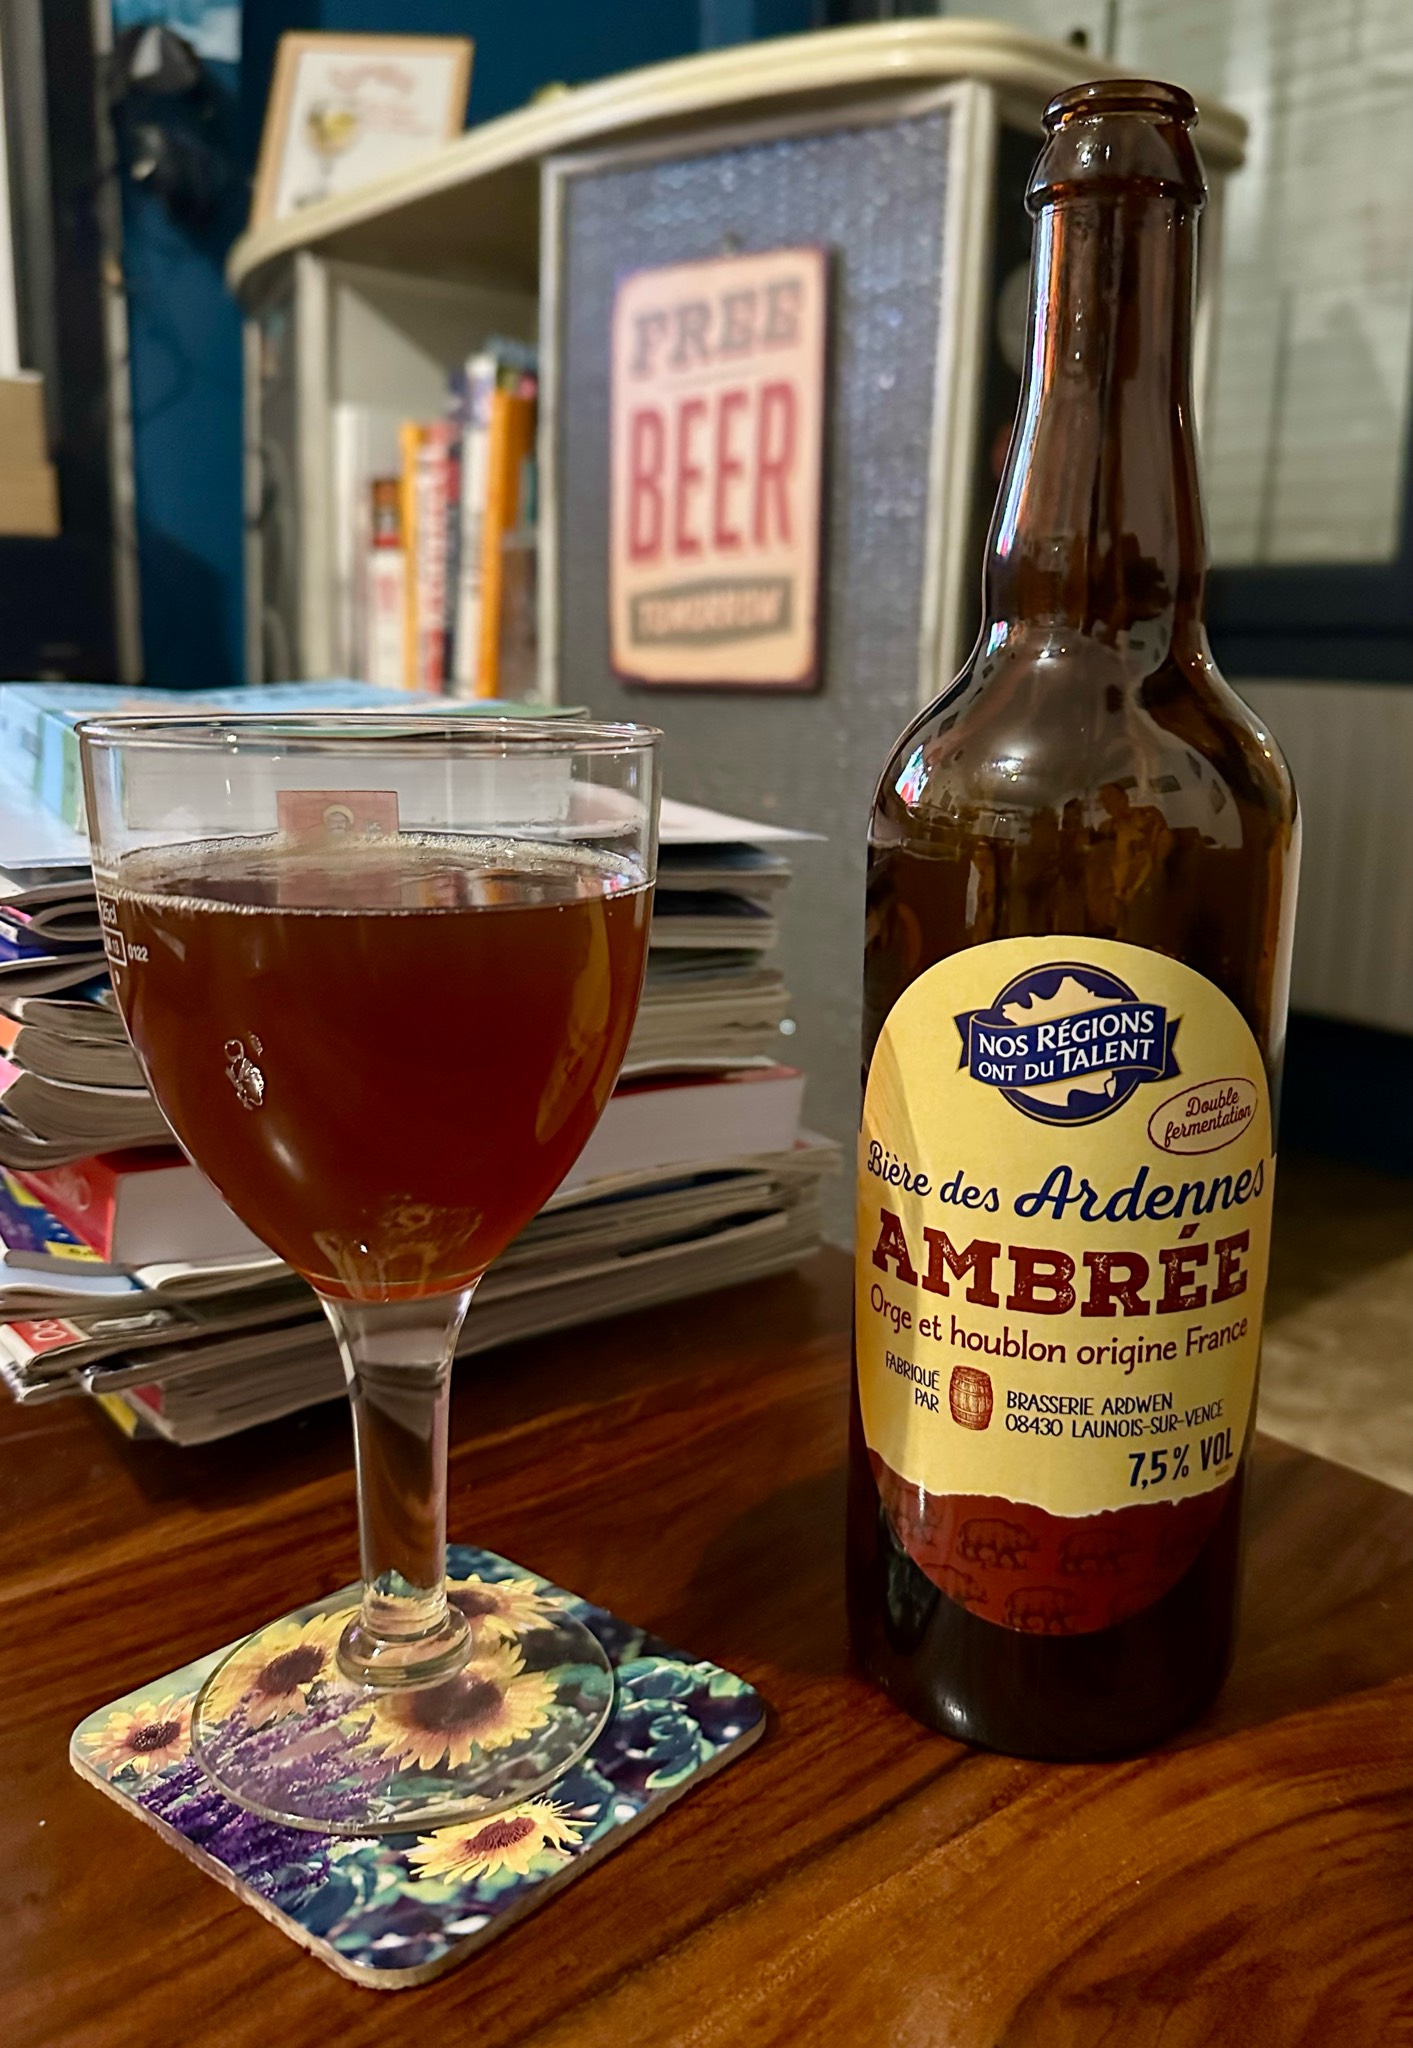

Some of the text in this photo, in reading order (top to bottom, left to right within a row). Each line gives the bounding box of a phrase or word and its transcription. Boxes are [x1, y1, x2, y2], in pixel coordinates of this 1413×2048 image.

[631, 277, 802, 380] FREE
[628, 381, 799, 563] BEER
[127, 942, 149, 962] 0122
[978, 1009, 1155, 1059] NOS RÉGIONS
[978, 1038, 1155, 1082] ONT DU TALENT
[1186, 1087, 1240, 1118] Double
[1164, 1104, 1252, 1148] fermentation
[867, 1141, 1266, 1222] Bière des Ardennes
[872, 1207, 1251, 1318] AMBRÉE
[870, 1283, 1248, 1375] Orge et houblon origine France
[885, 1350, 940, 1391] FABRIQUÉ
[914, 1389, 940, 1414] PAR
[1005, 1399, 1225, 1438] 08430 LAUNOIS-SUR-VENCE
[1006, 1391, 1173, 1416] BRASSERIE ARDWEN
[1200, 1427, 1233, 1471] VOL
